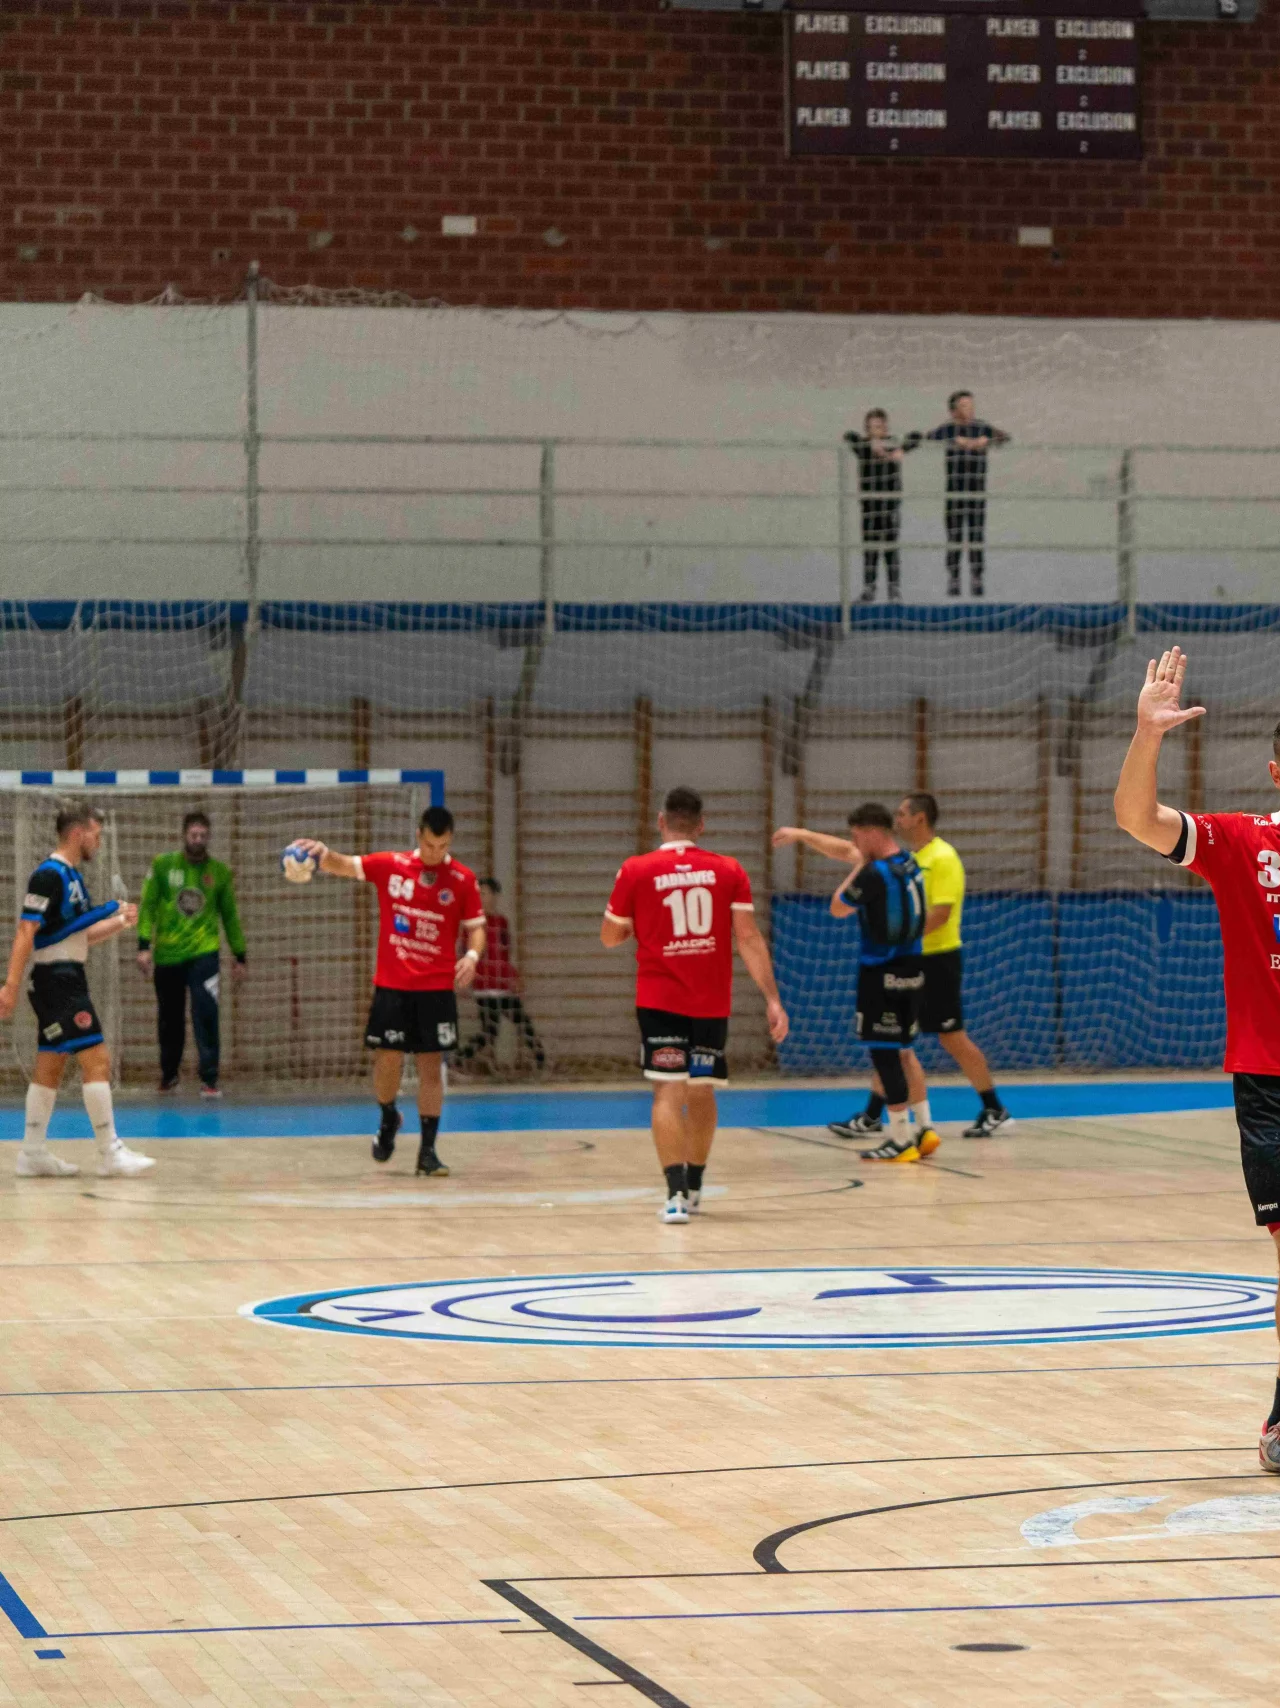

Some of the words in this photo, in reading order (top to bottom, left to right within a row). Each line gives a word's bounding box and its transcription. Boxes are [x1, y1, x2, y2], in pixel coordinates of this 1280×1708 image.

[795, 14, 849, 34] PLAYER
[864, 15, 945, 35] EXCLUSION
[986, 18, 1039, 37] PLAYER
[1055, 19, 1134, 39] EXCLUSION
[796, 61, 850, 80] PLAYER
[865, 62, 946, 82] EXCLUSION
[987, 64, 1040, 83] PLAYER
[1056, 65, 1135, 85] EXCLUSION
[797, 107, 850, 127] PLAYER
[866, 108, 947, 128] EXCLUSION
[988, 110, 1041, 130] PLAYER
[1057, 111, 1136, 131] EXCLUSION
[662, 887, 713, 937] 10
[1257, 1203, 1279, 1212] Kempa
